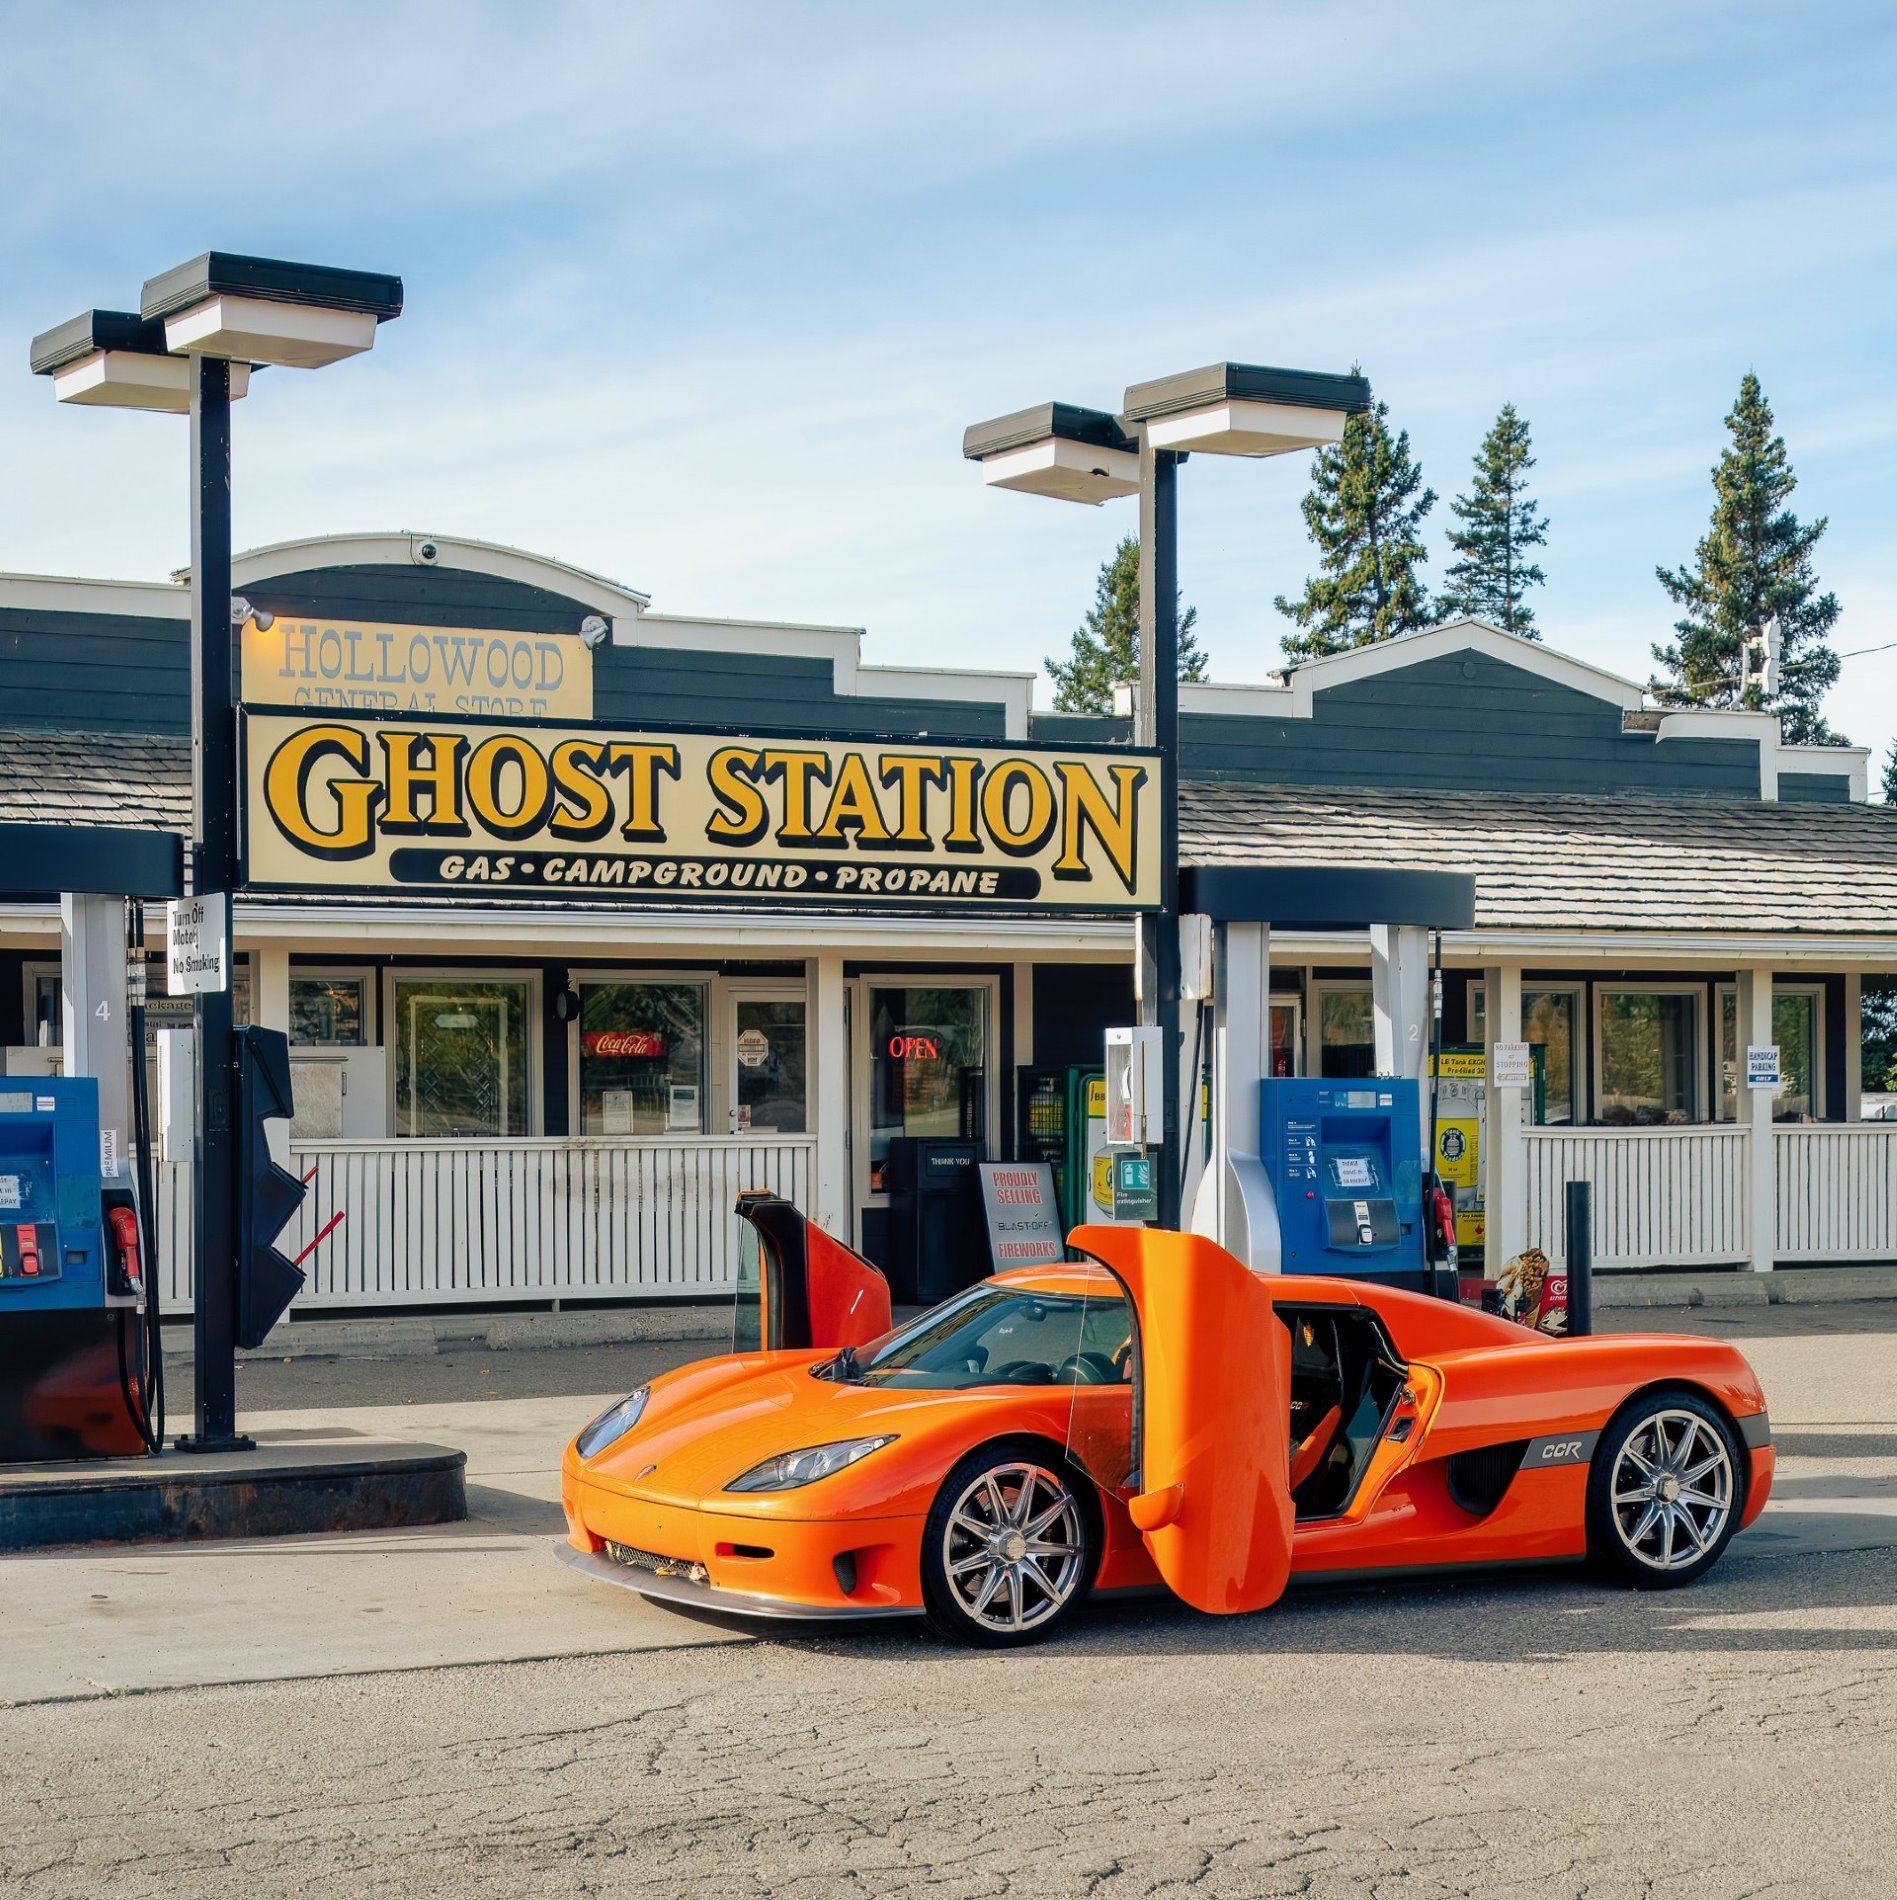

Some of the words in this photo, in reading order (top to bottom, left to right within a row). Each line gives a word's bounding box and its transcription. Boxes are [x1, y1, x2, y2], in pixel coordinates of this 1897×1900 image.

[279, 624, 563, 691] HOLLOWOOD
[263, 723, 682, 862] GHOST
[706, 746, 1148, 896] STATION
[439, 855, 516, 881] GAS
[543, 858, 808, 889] CAMPGROUND
[835, 866, 1000, 895] PROPANE
[173, 911, 191, 927] Turn
[192, 906, 205, 924] Off
[173, 958, 184, 974] No
[186, 953, 220, 973] Smoking
[95, 1000, 111, 1021] 4
[1409, 1023, 1419, 1041] 2
[596, 1034, 648, 1055] Coca-Cola
[889, 1036, 938, 1059] OPEN
[1495, 1043, 1503, 1051] NO
[1749, 1052, 1778, 1061] HANDICAP
[1751, 1062, 1776, 1071] PARKING
[104, 1131, 113, 1177] PREMIUM
[931, 1157, 954, 1166] THANK
[955, 1157, 970, 1166] YOU
[992, 1171, 1038, 1187] PROUDLY
[997, 1188, 1042, 1205] SELLING
[998, 1241, 1057, 1258] FIREWORKS
[1542, 1441, 1582, 1459] CCR
